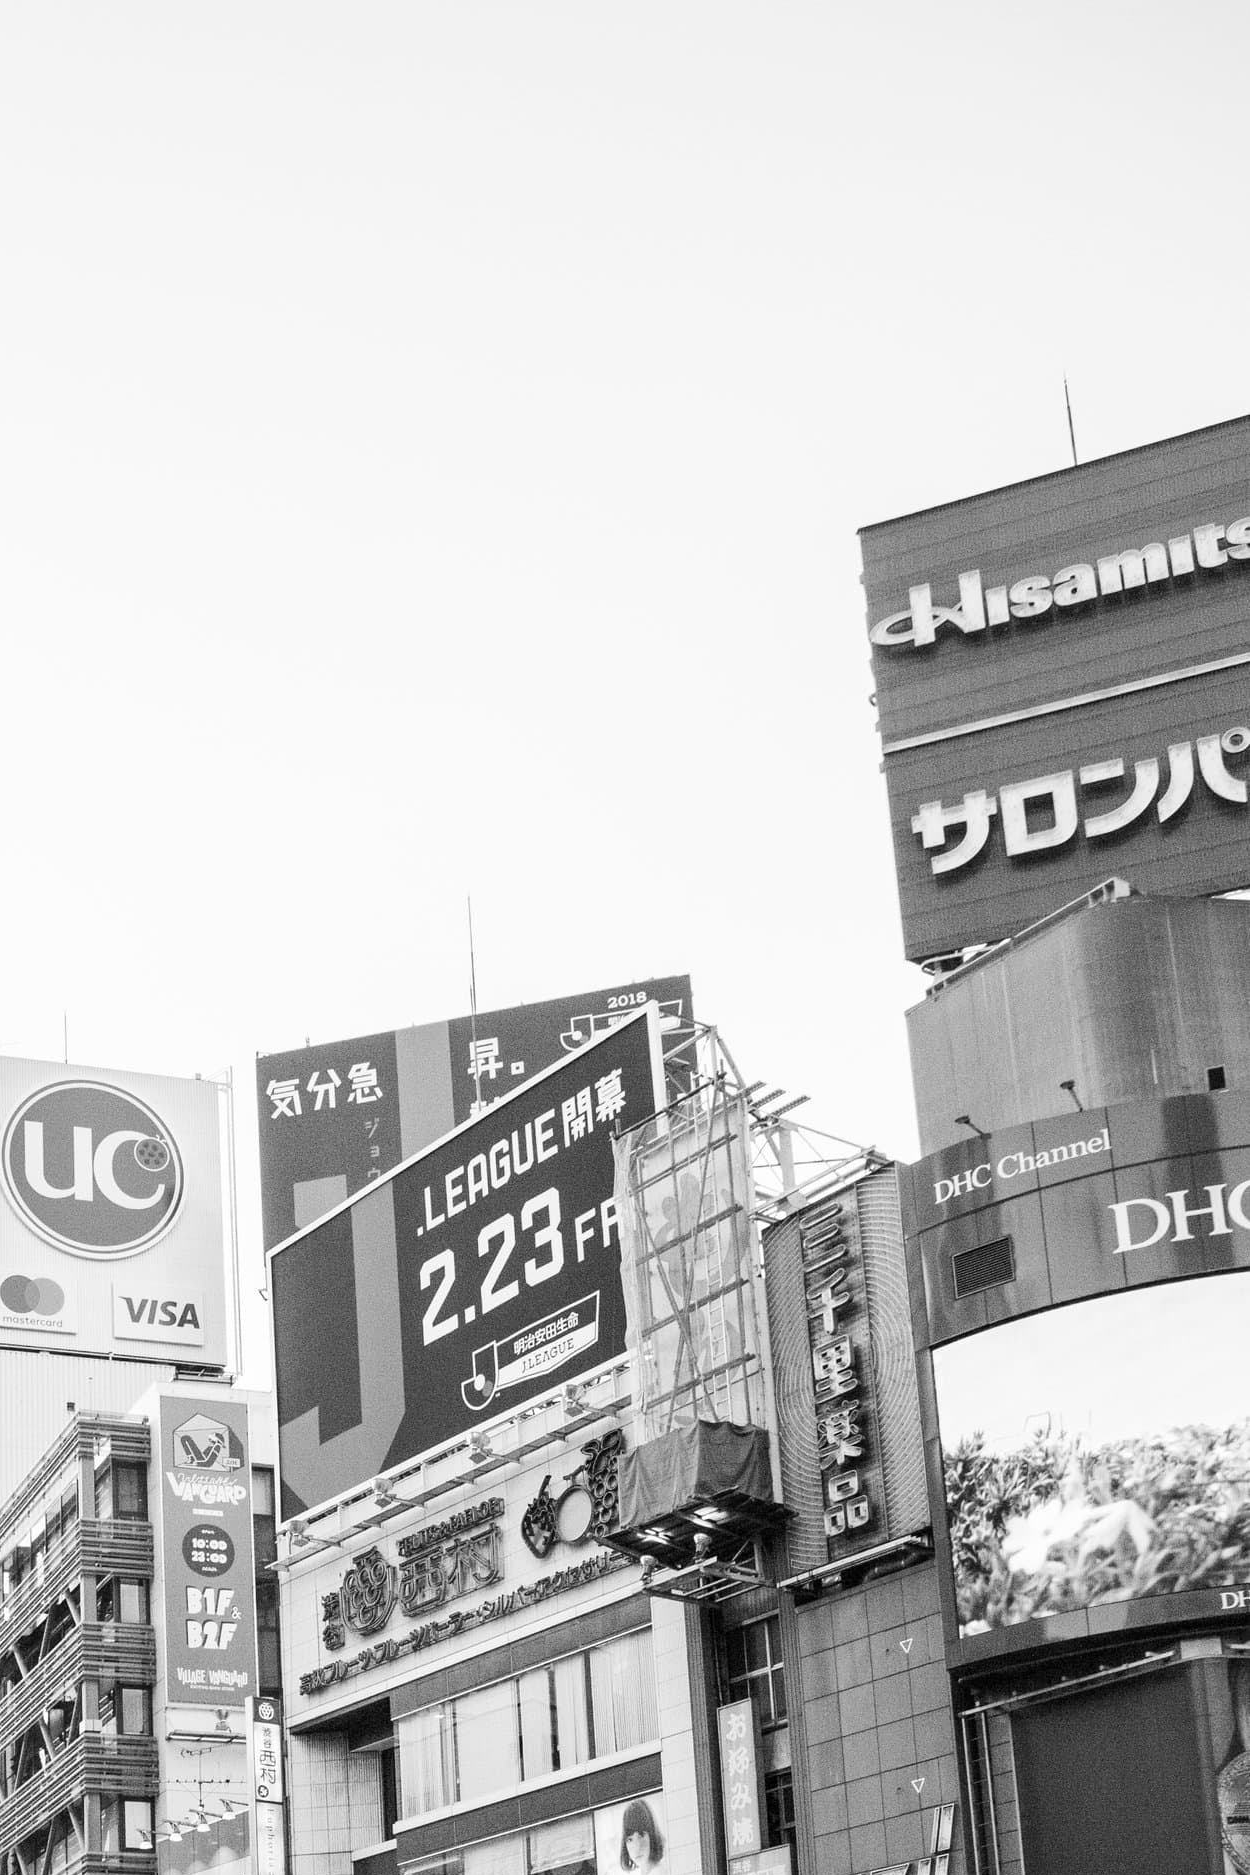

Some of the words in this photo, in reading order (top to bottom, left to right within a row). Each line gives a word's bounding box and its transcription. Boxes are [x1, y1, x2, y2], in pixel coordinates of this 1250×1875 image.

[607, 991, 647, 1009] 2018
[266, 1062, 384, 1119] 気分急
[561, 1068, 628, 1148] 開幕
[934, 1165, 993, 1205] DHC
[996, 1129, 1112, 1180] Channel
[1109, 1181, 1250, 1254] DH
[419, 1186, 566, 1347] 2.23
[2, 1315, 63, 1329] mastercard
[119, 1296, 201, 1331] VISA
[513, 1311, 580, 1357] 明治安田生命
[185, 1585, 234, 1617] B1F
[185, 1619, 238, 1650] B2F
